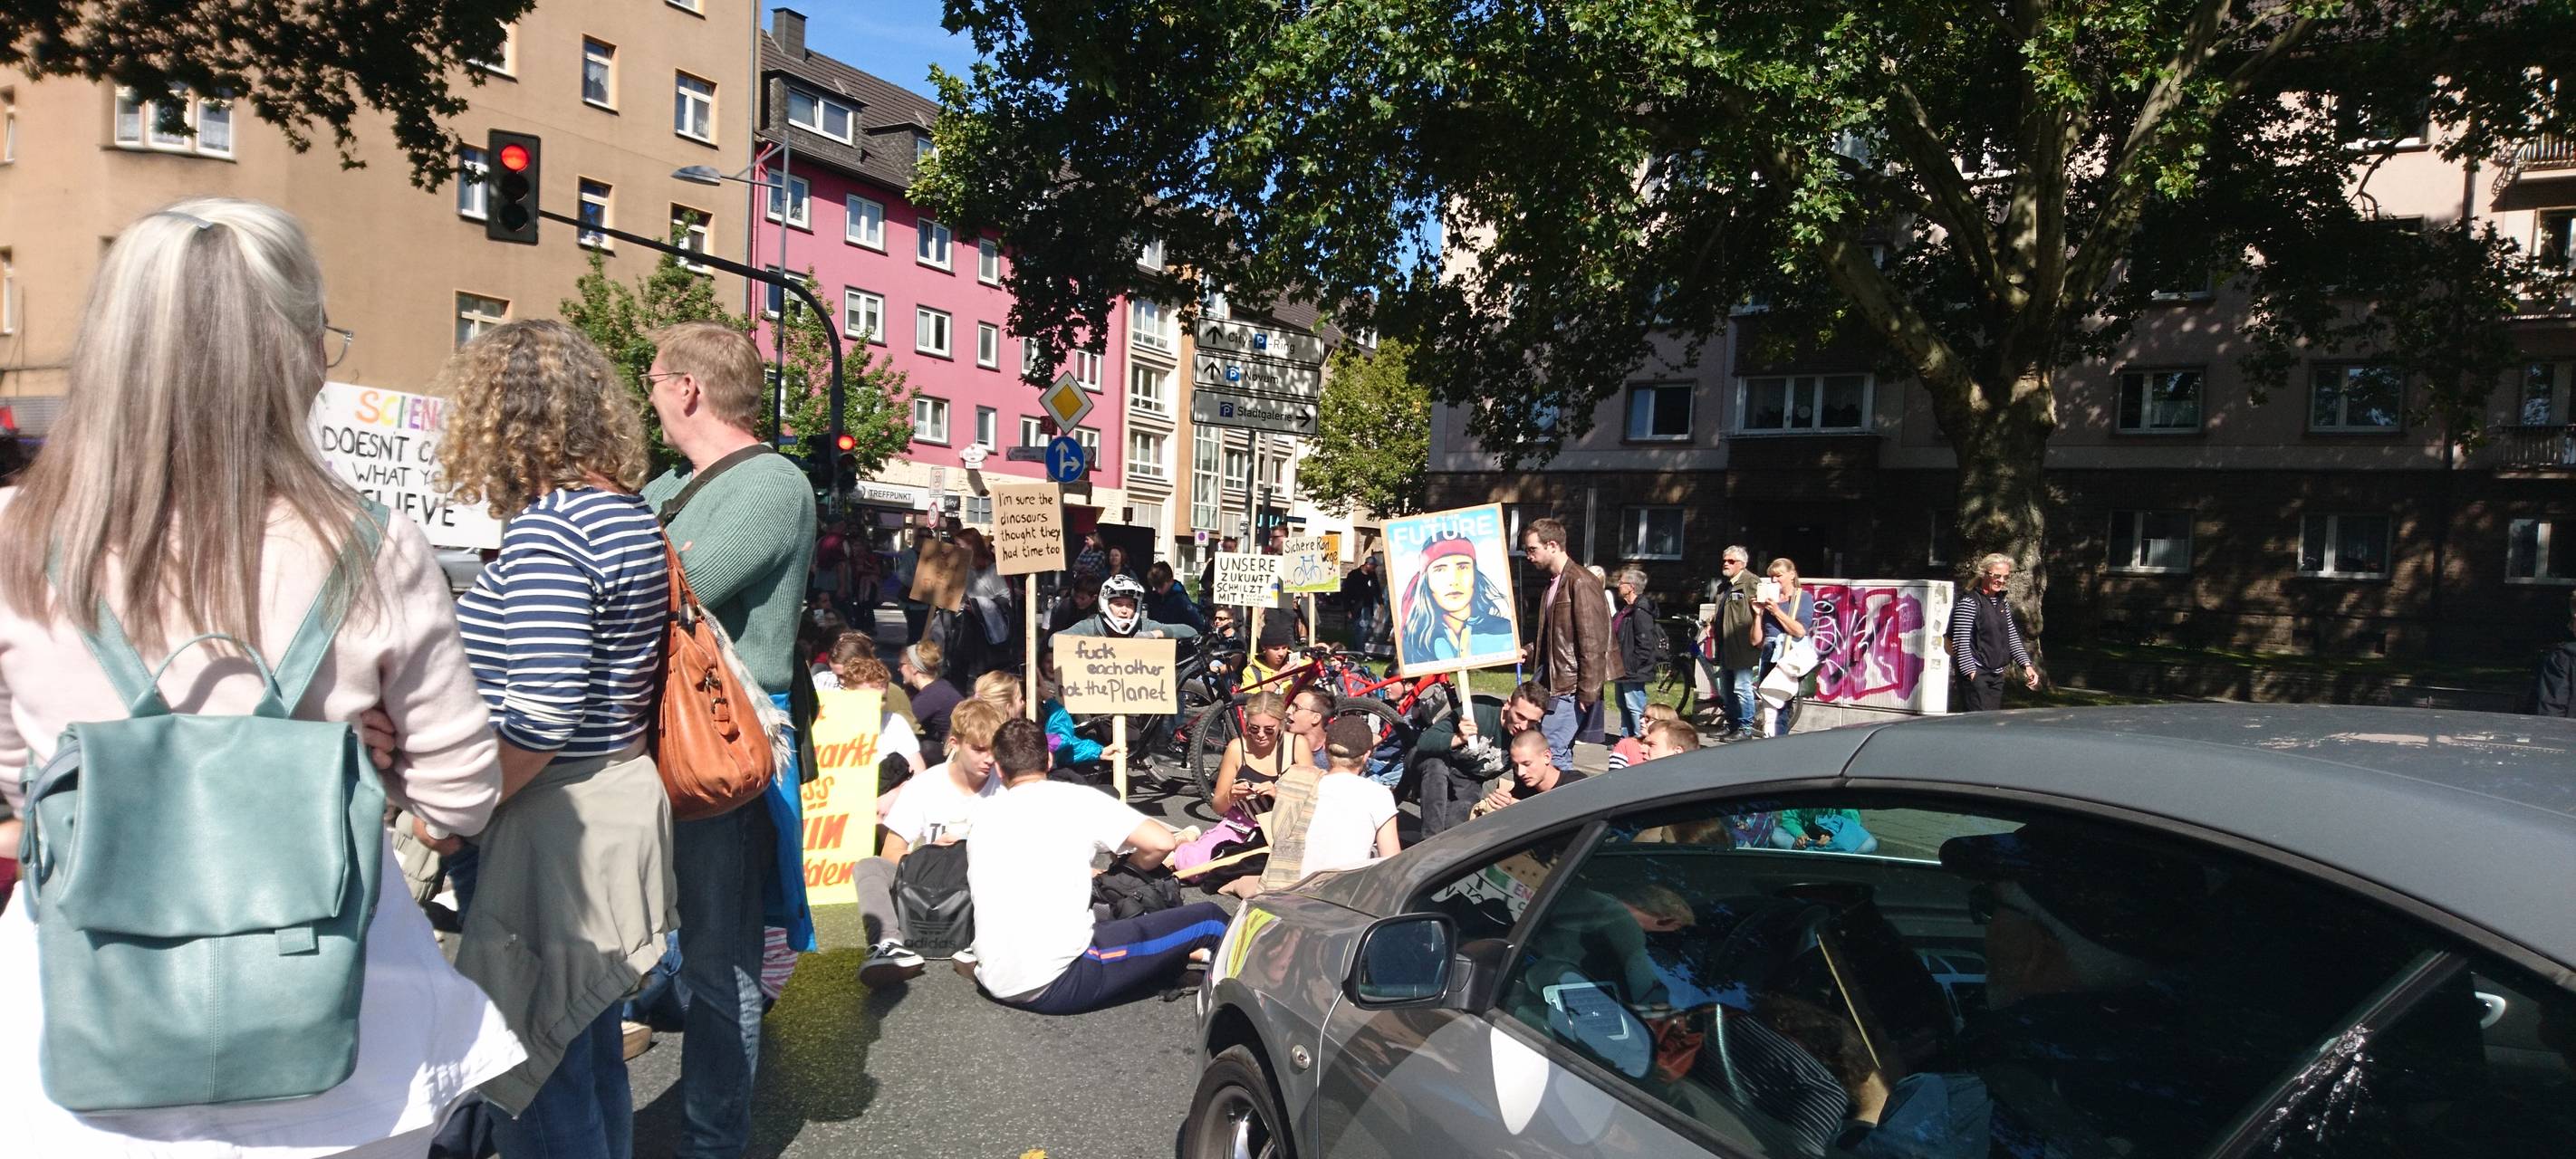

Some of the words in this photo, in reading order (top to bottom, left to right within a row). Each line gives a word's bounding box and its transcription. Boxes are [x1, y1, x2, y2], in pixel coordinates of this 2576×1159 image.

[1244, 370, 1279, 385] Novum
[1236, 406, 1293, 423] Stadtgalerie
[352, 462, 411, 487] WHAT
[869, 489, 912, 501] TREFFPUNKT
[998, 492, 1013, 507] I'm
[1015, 495, 1036, 505] sure
[1039, 492, 1053, 505] the
[1000, 512, 1048, 525] dinosaurs
[1000, 527, 1037, 544] thought
[1040, 526, 1061, 541] they
[1392, 513, 1495, 545] FUTURE
[1002, 546, 1018, 560] had
[1022, 545, 1043, 558] time
[1045, 543, 1061, 555] too
[1284, 539, 1314, 553] Sichere
[1316, 536, 1331, 551] Rad
[1219, 557, 1276, 572] UNSERE
[1221, 572, 1272, 583] ZUKUNFT
[1216, 582, 1264, 594] SCHMILZT
[1075, 640, 1116, 660] fuck
[1086, 662, 1123, 675] each
[1123, 659, 1165, 676] other
[1085, 680, 1109, 696] the
[1107, 678, 1168, 704] Planet
[802, 813, 850, 851] IN
[803, 858, 856, 888] den
[903, 937, 957, 950] adidas
